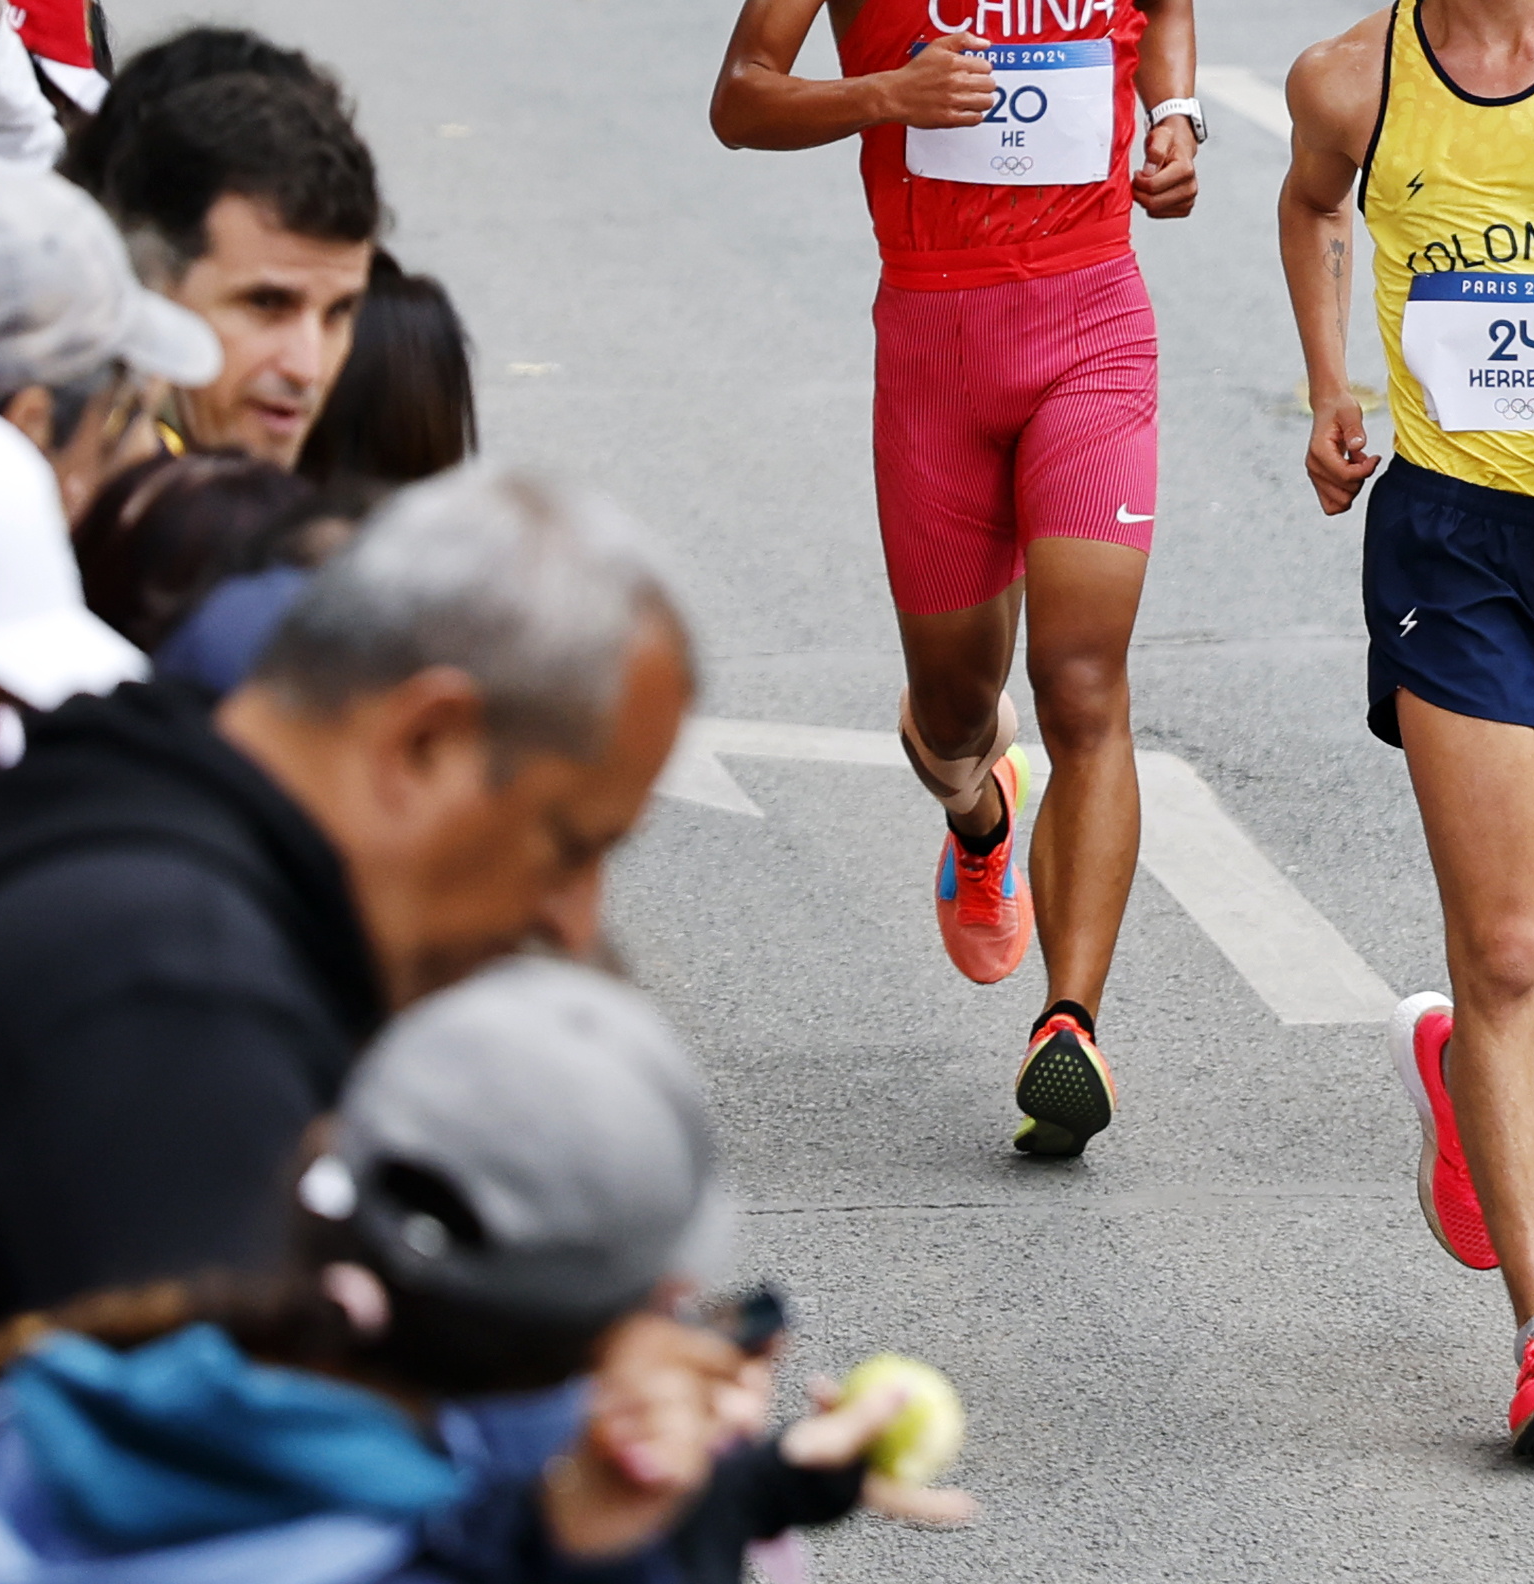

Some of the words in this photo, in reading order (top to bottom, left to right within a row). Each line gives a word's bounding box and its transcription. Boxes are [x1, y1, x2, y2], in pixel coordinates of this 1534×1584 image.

[1022, 49, 1066, 64] 2024
[982, 85, 1048, 124] 20
[1001, 130, 1025, 147] HE
[1461, 279, 1517, 295] PARIS
